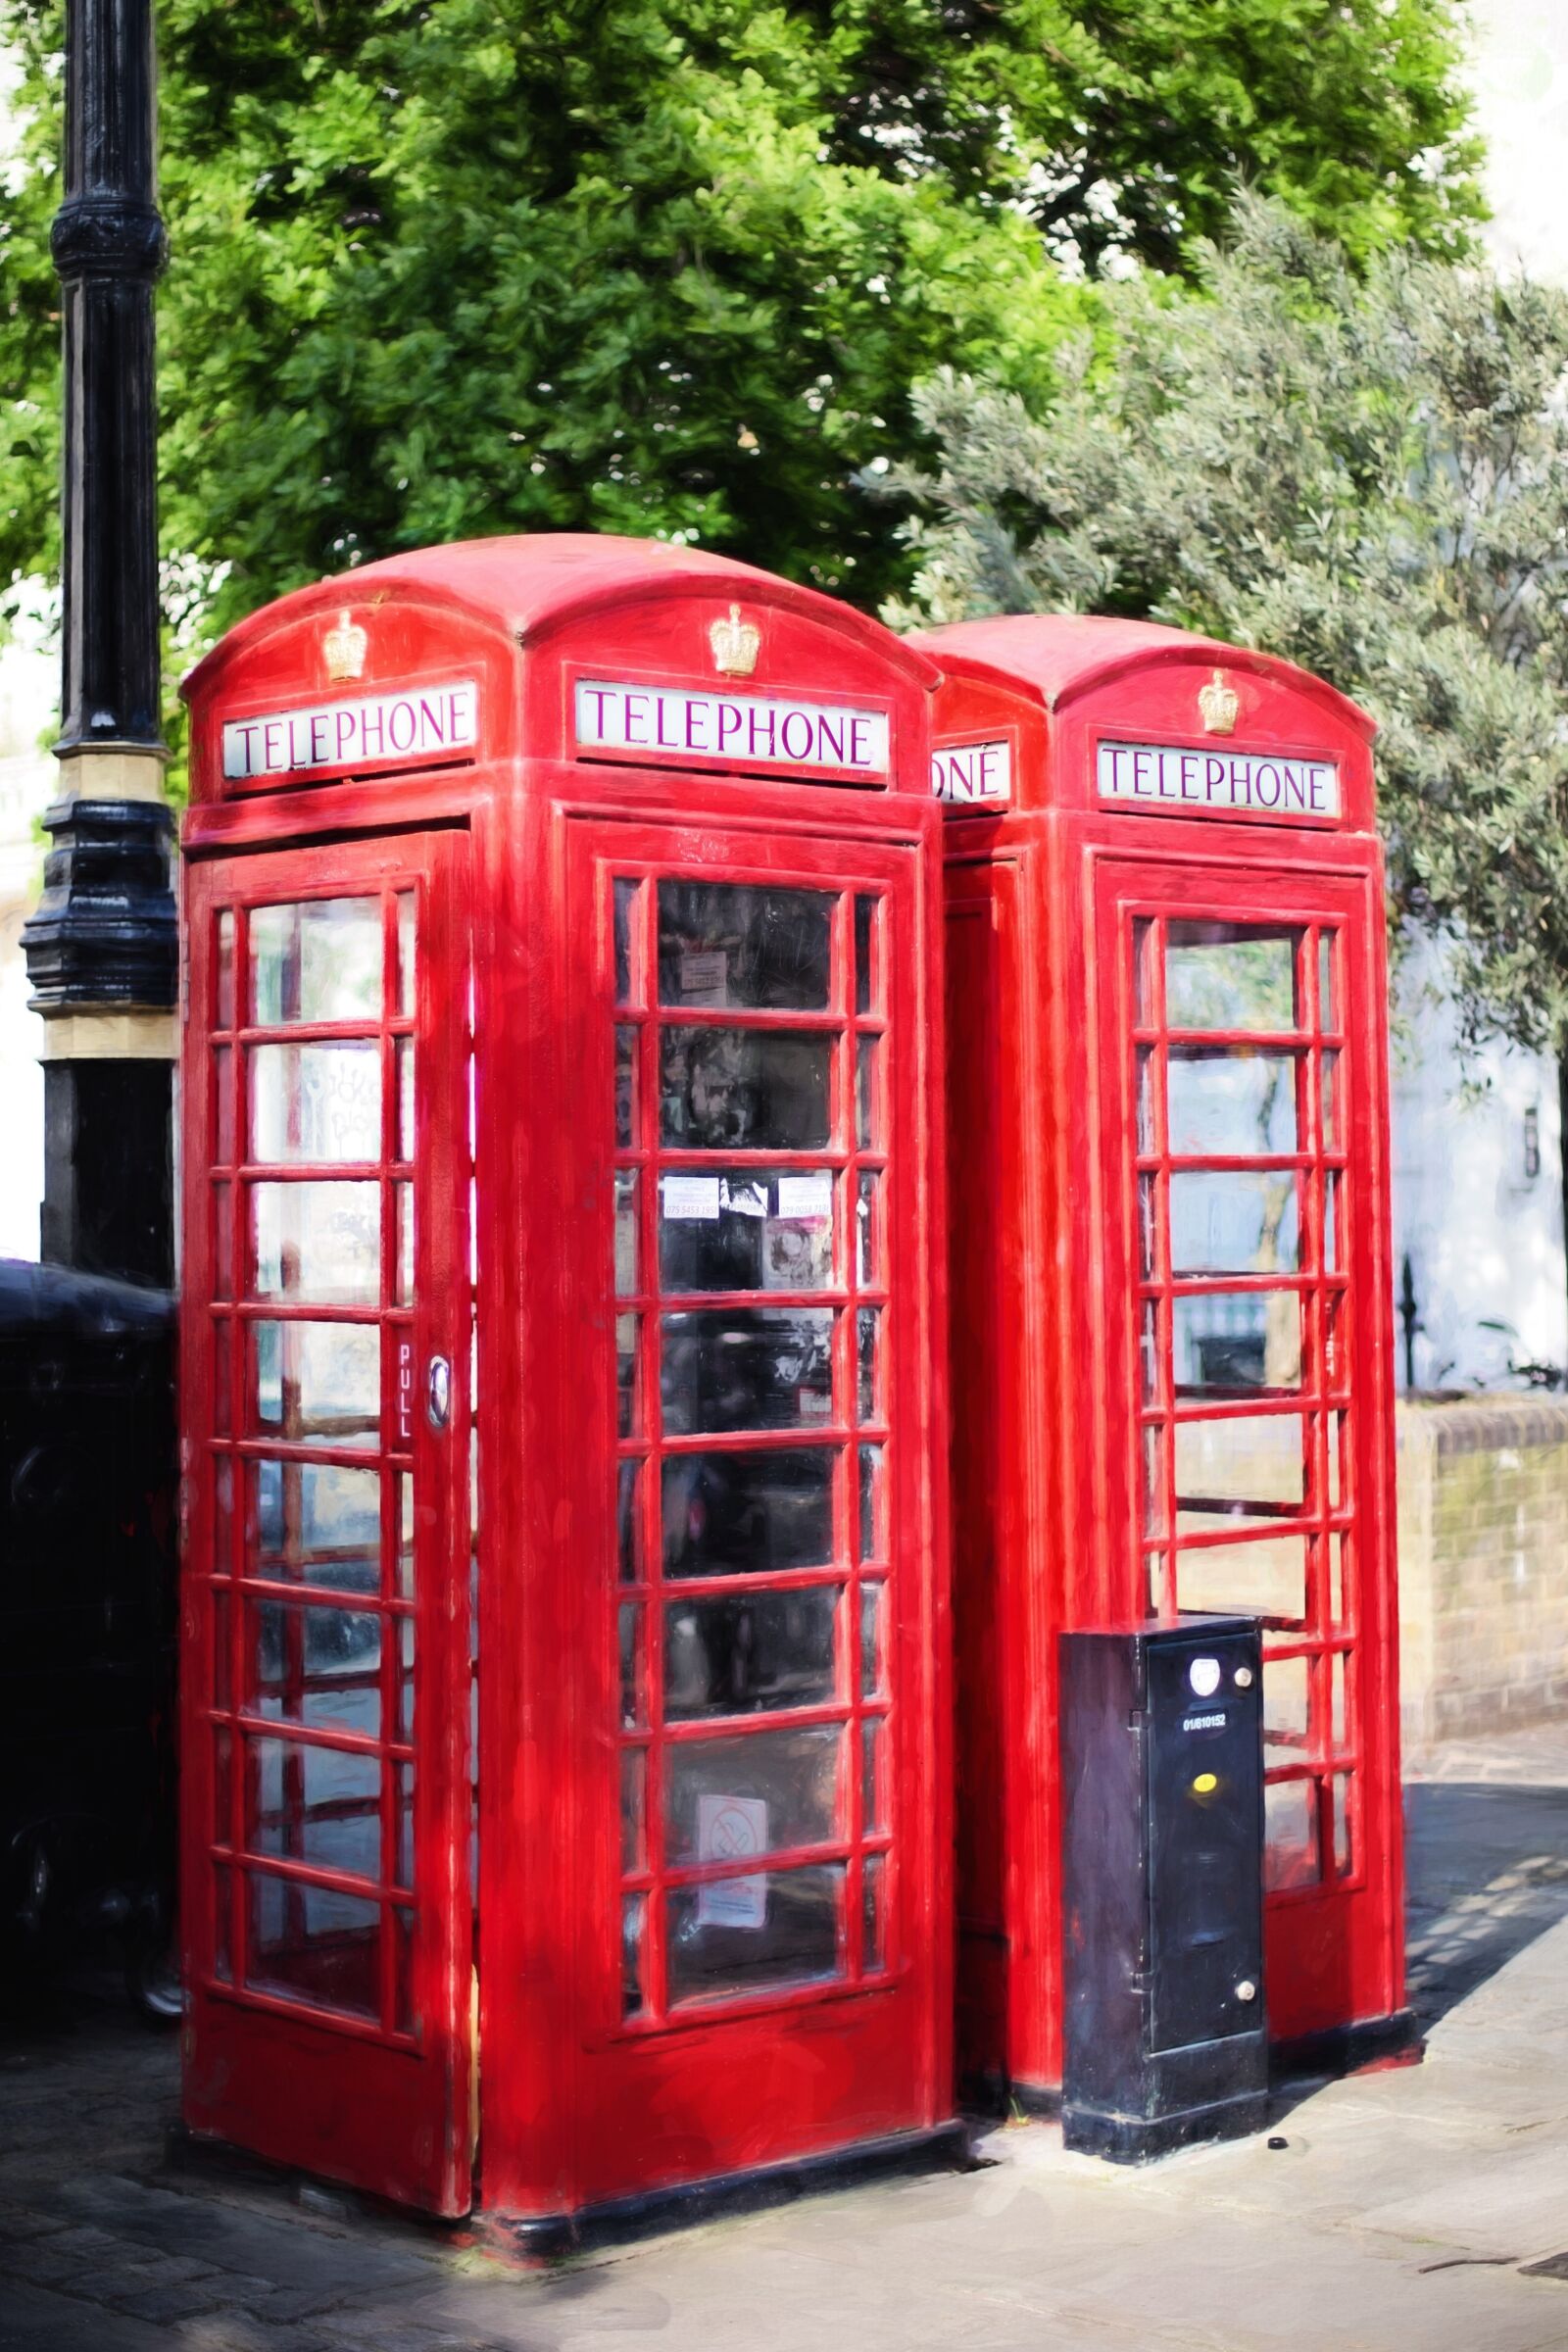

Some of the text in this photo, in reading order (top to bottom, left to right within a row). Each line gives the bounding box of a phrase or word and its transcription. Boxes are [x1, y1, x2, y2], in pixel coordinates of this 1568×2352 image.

[235, 692, 469, 773] TELEPHONE
[584, 690, 871, 765] TELEPHONE
[1102, 748, 1326, 809] TELEPHONE
[400, 1345, 412, 1438] PULL
